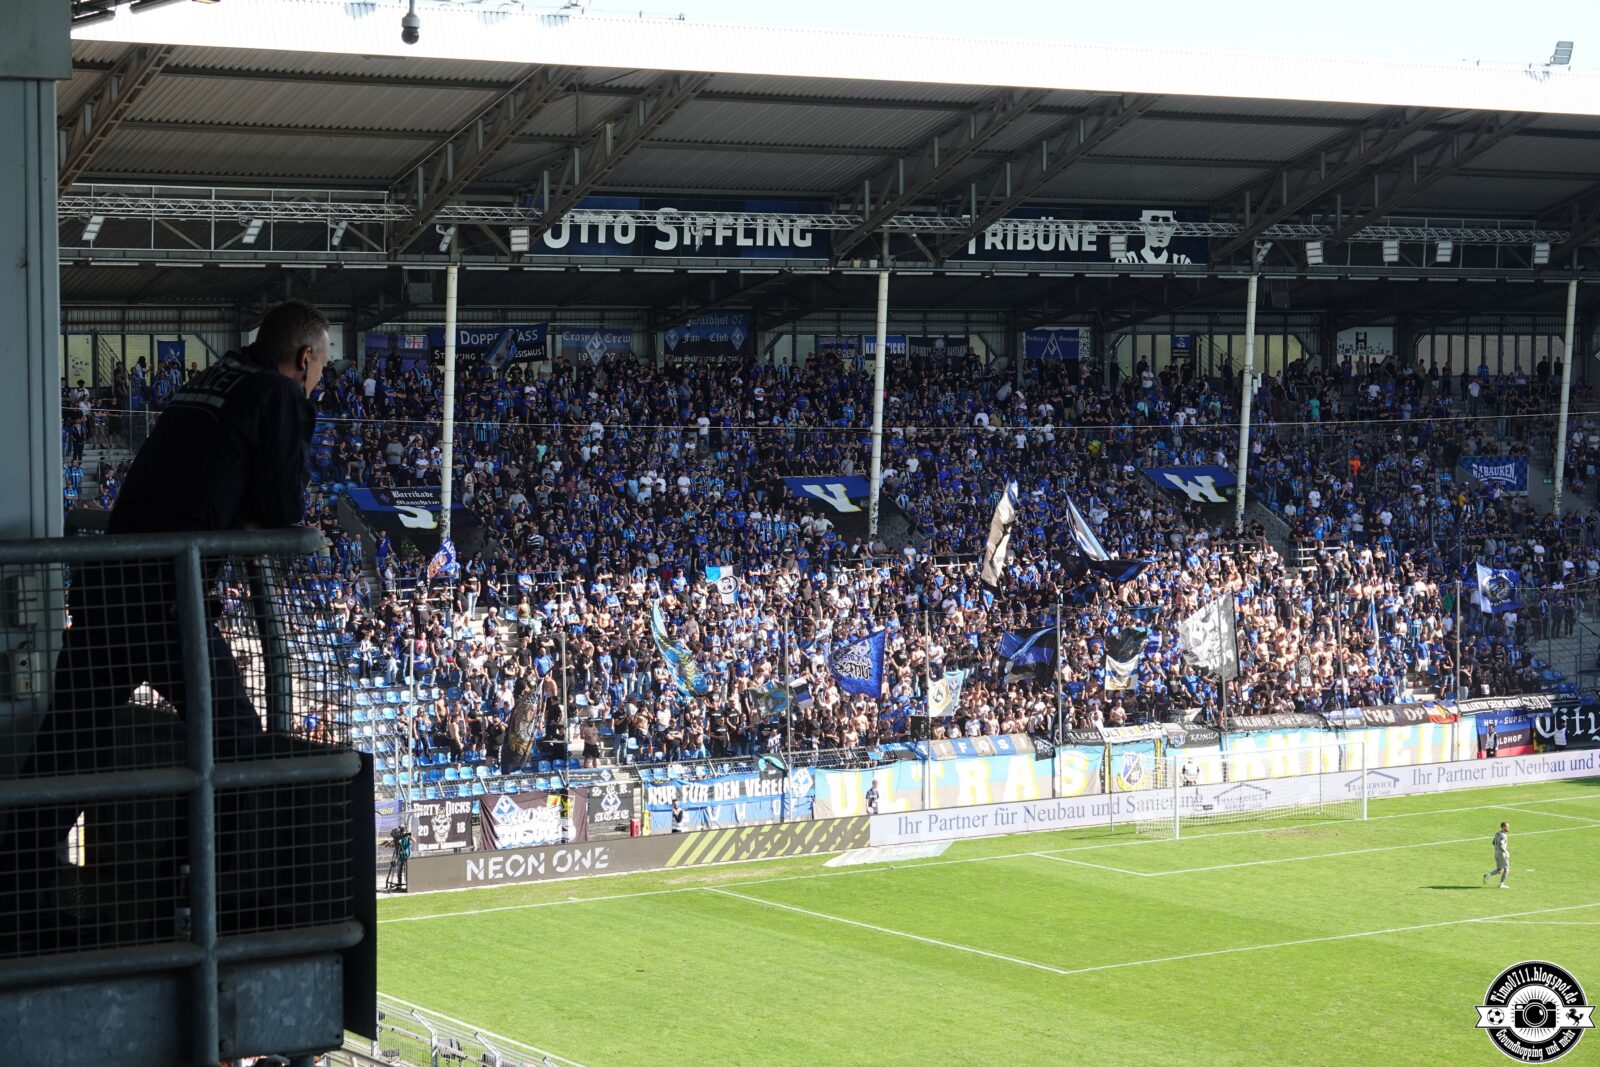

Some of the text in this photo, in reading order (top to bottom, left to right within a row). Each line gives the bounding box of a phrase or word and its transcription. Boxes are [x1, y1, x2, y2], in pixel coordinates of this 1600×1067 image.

[655, 208, 812, 250] SIFFLING
[1412, 768, 1432, 786] Ihr
[1437, 766, 1486, 784] Partner
[1491, 761, 1509, 778] für
[1515, 757, 1564, 777] Neubau
[1571, 752, 1593, 771] und
[682, 781, 709, 803] FÜR
[715, 779, 741, 801] DEN
[446, 801, 471, 816] DICKS
[898, 815, 922, 836] Ihr
[928, 811, 988, 833] Partner
[994, 806, 1017, 826] für
[1023, 800, 1087, 823] Neubau
[1091, 797, 1120, 817] und
[418, 826, 428, 836] 20
[466, 847, 609, 881] NEON ONE
